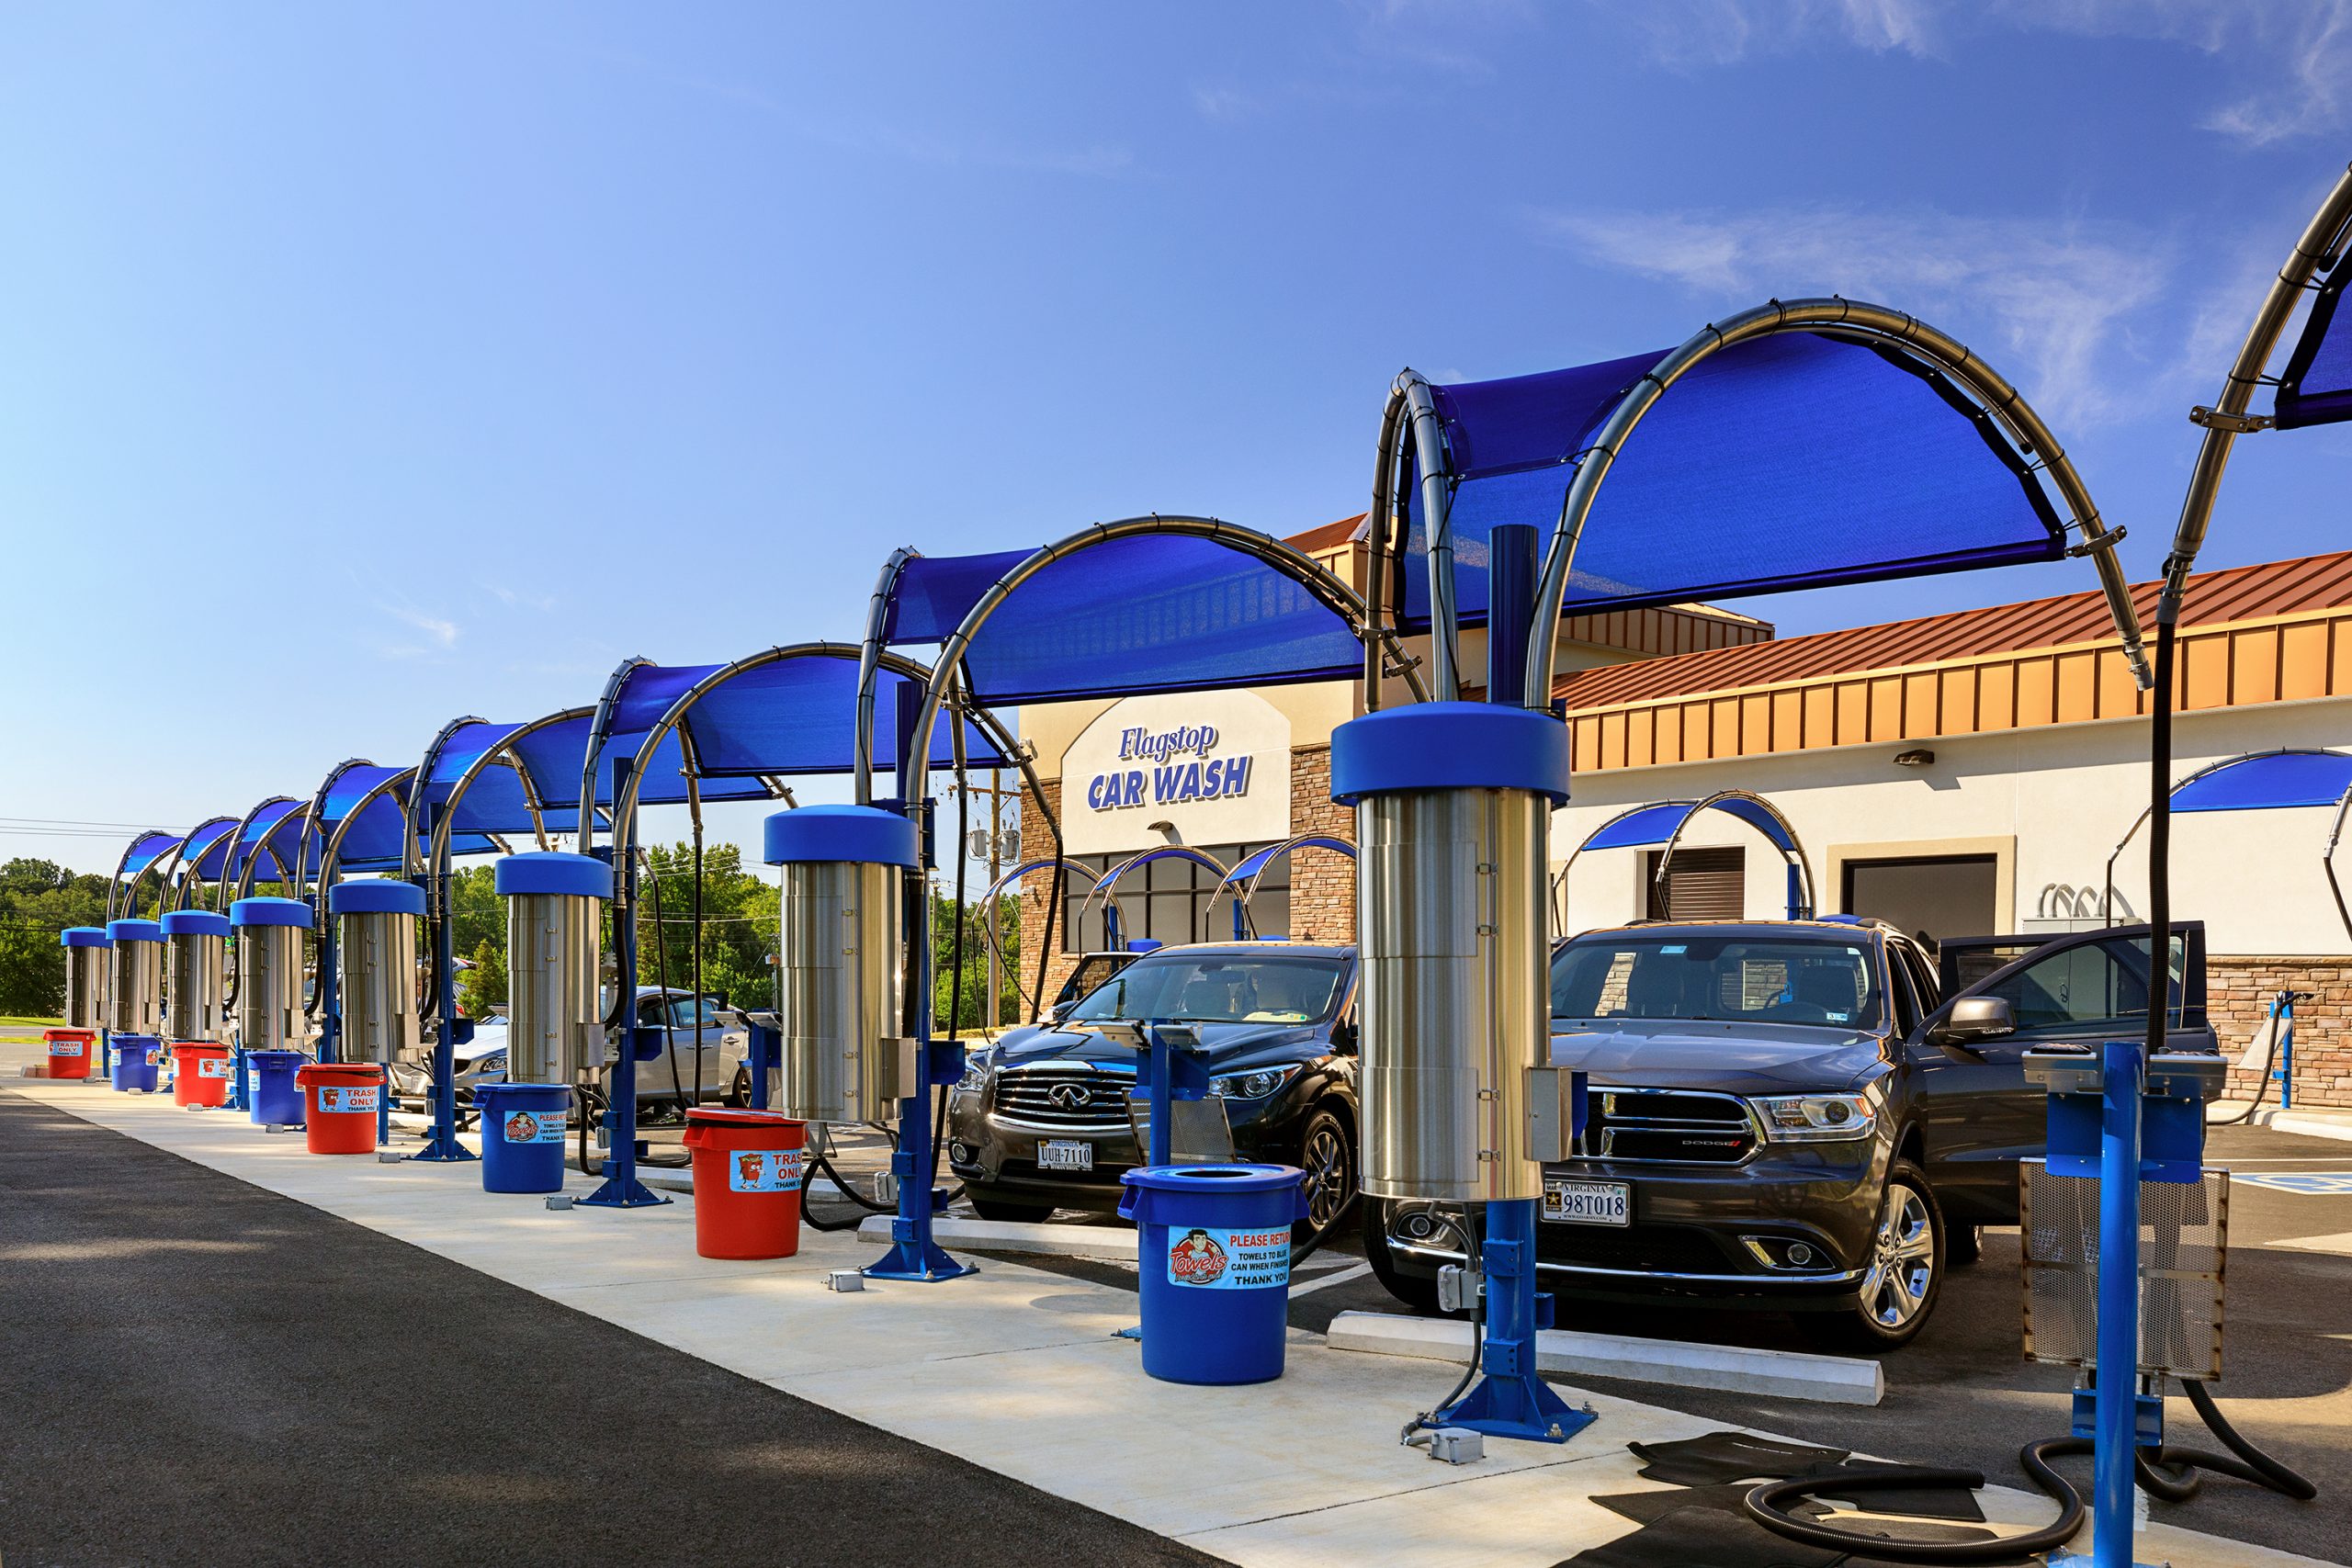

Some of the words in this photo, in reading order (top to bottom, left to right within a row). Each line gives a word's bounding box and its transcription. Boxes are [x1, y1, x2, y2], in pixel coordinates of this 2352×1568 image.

[1118, 725, 1218, 764] Flagstop
[1088, 770, 1147, 811] CAR
[1154, 755, 1253, 805] WASH
[349, 1098, 374, 1106] ONLY
[773, 1153, 801, 1166] TRAS
[1041, 1147, 1091, 1163] UUH-7110
[1564, 1183, 1606, 1193] VIRGINIA
[1564, 1194, 1623, 1216] 98T018
[1229, 1235, 1268, 1247] PLEASE
[1238, 1252, 1267, 1261] TOWELS
[1268, 1251, 1276, 1259] TO
[1170, 1251, 1228, 1274] Towels
[1231, 1263, 1248, 1271] CAN
[1250, 1261, 1270, 1271] WHEN
[1235, 1275, 1272, 1285] THANK
